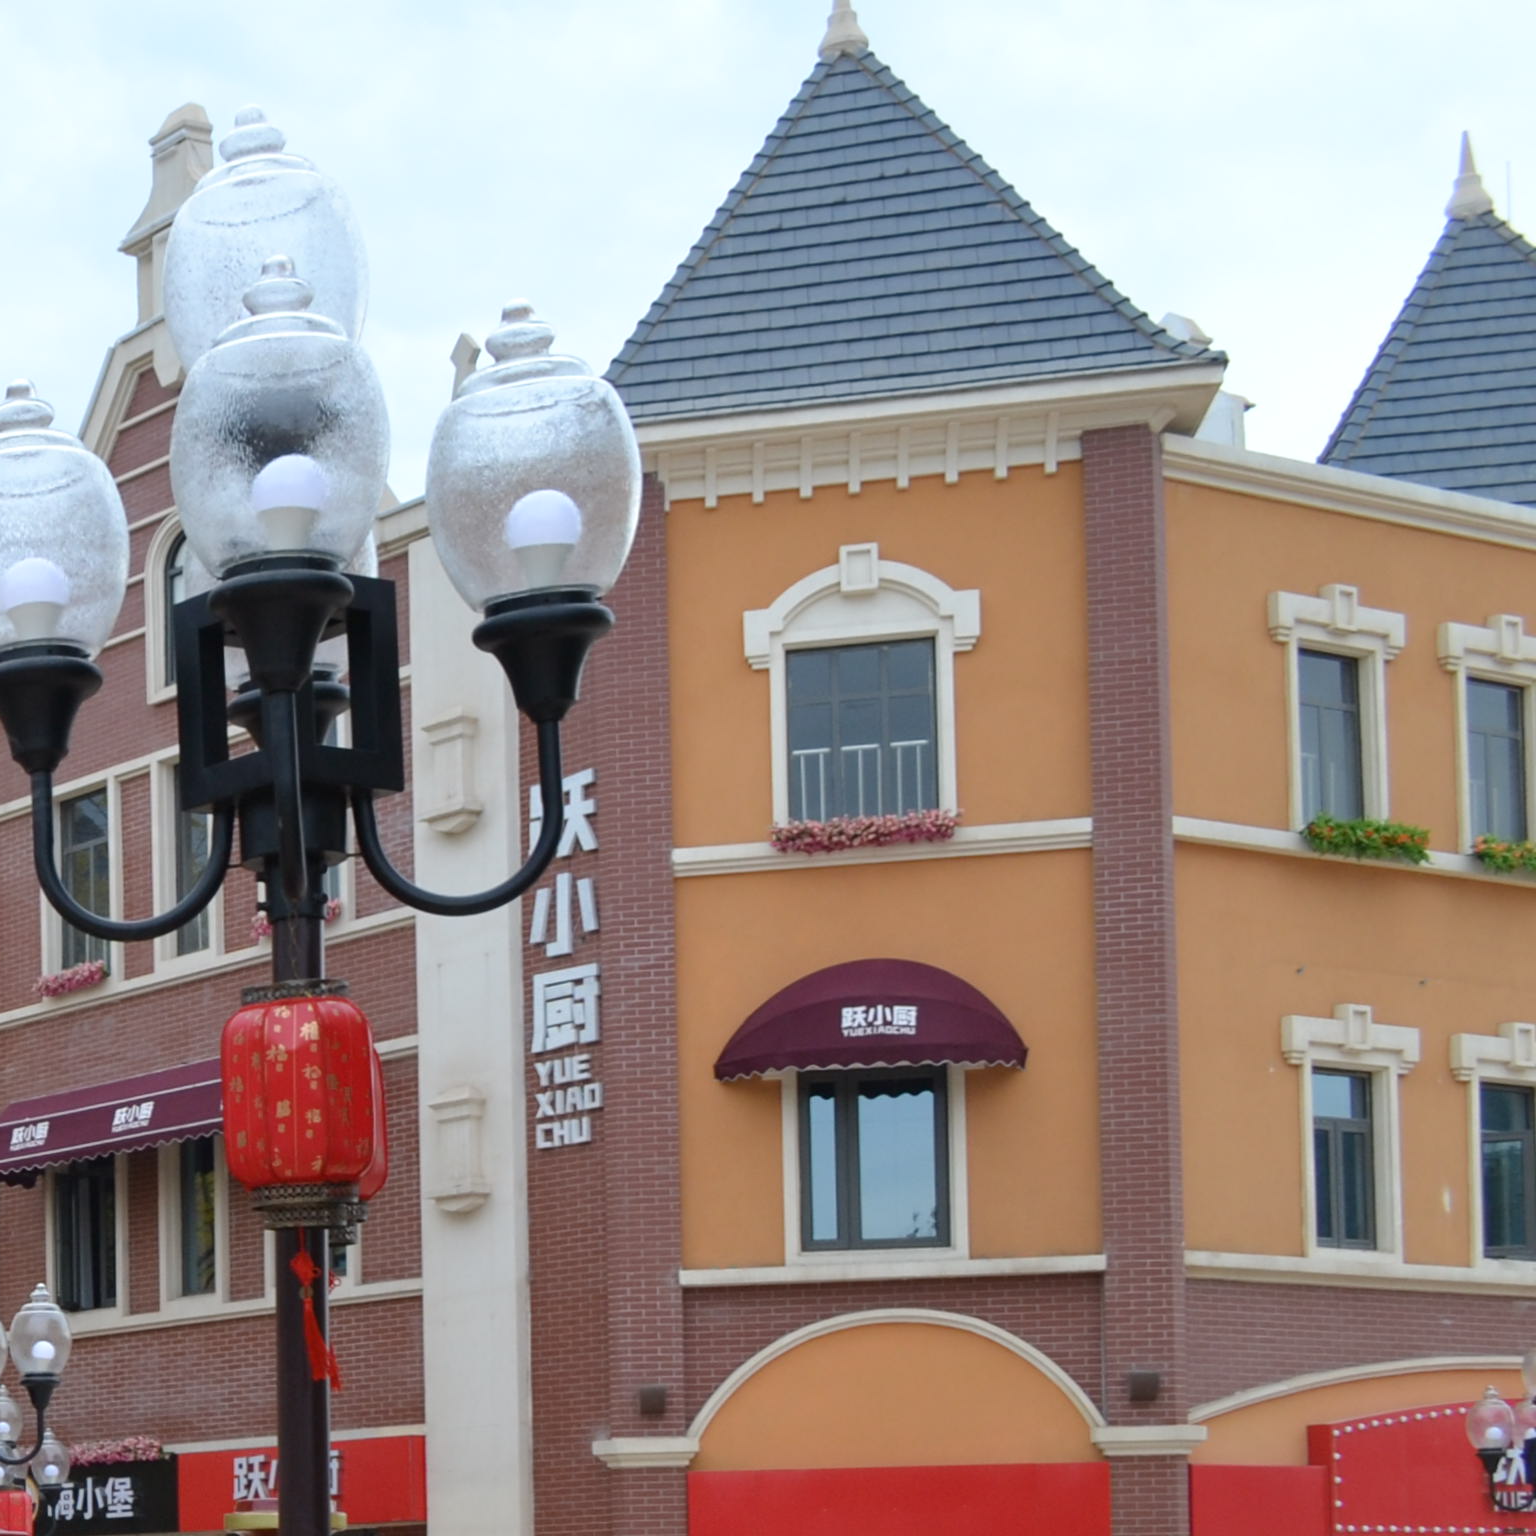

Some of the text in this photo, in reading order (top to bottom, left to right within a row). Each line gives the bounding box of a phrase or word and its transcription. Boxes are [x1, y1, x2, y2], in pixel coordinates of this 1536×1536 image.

[528, 767, 600, 1053] 跃小厨
[841, 1004, 917, 1028] 跃小厨
[534, 1053, 592, 1087] YUE
[535, 1081, 603, 1119] XIAO
[536, 1116, 592, 1150] CHU
